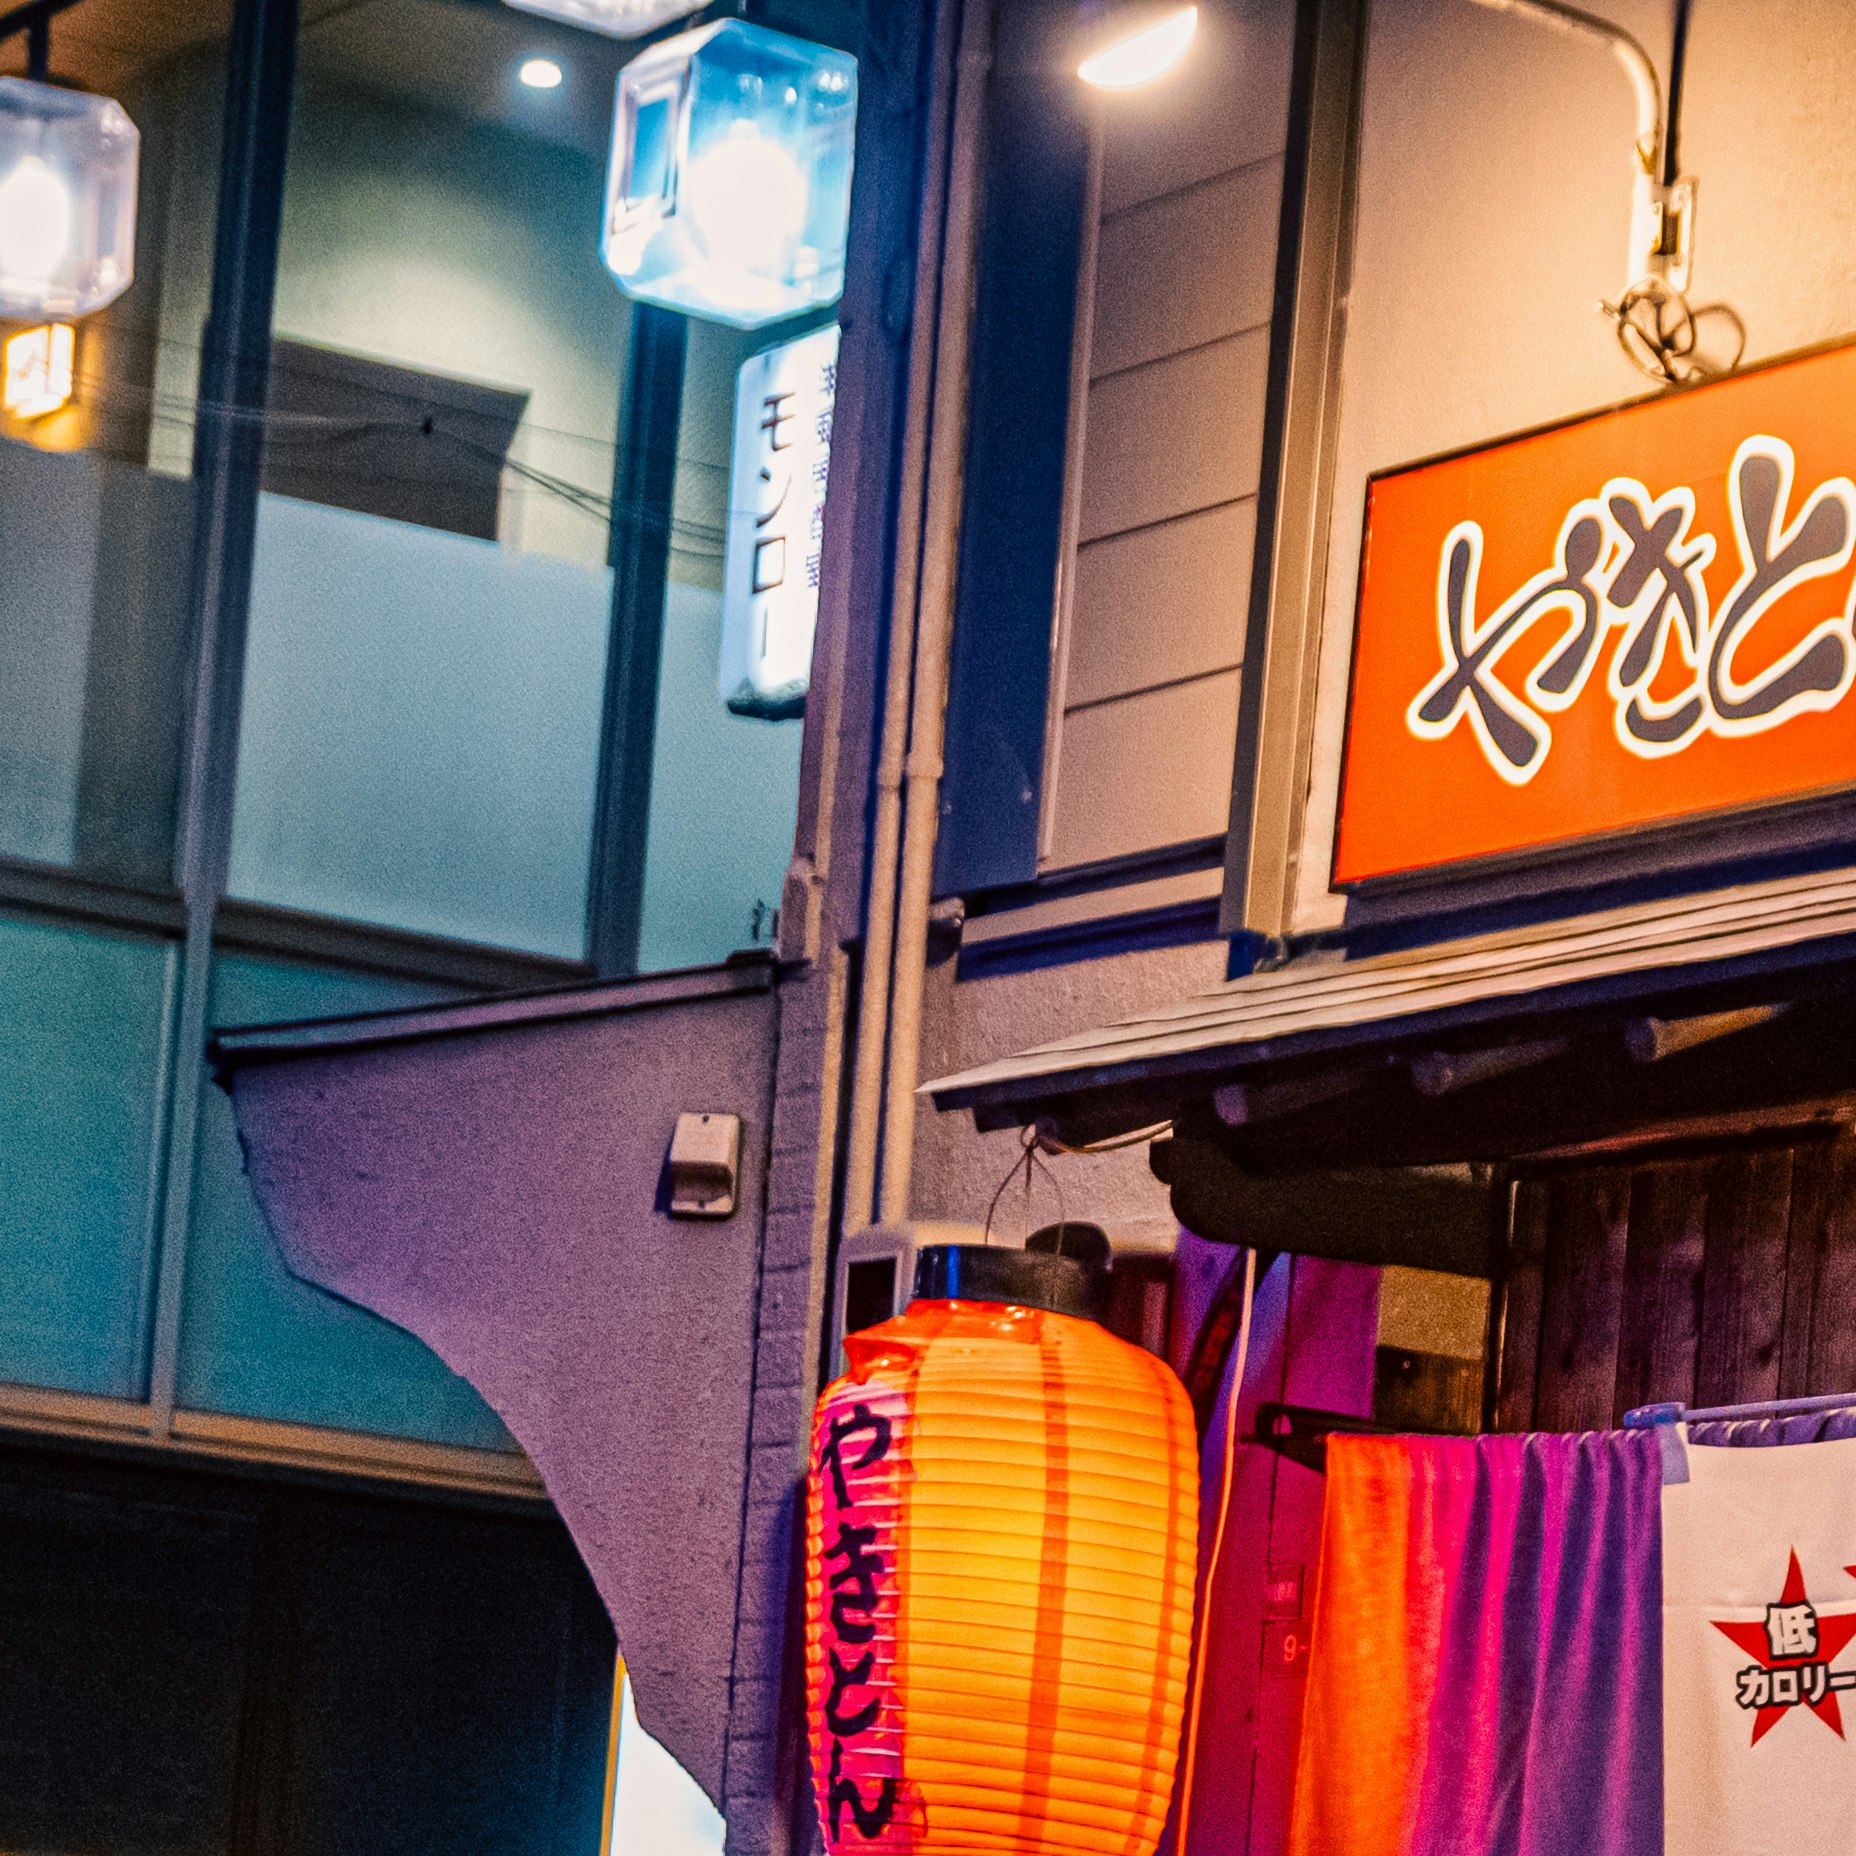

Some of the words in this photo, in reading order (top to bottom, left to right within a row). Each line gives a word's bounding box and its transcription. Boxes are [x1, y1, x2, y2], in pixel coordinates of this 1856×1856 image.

[751, 391, 796, 658] モンロー
[820, 1403, 906, 1844] やきとん
[1762, 1601, 1820, 1660] 低
